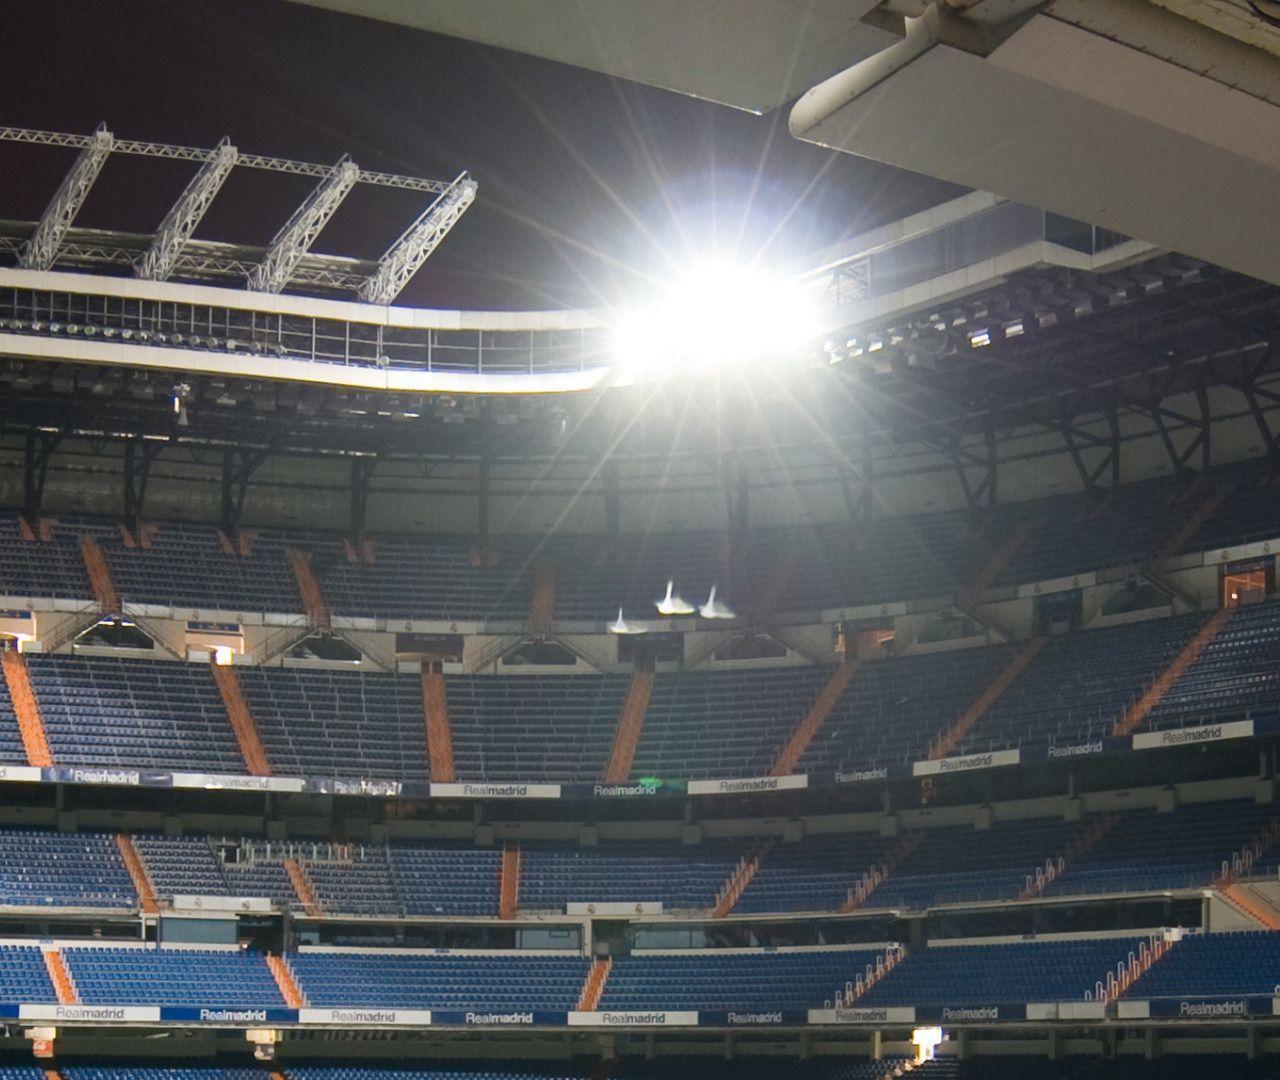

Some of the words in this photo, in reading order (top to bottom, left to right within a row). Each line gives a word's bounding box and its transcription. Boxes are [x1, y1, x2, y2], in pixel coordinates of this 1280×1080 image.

[1163, 727, 1222, 744] Realmadrid
[1049, 741, 1103, 757] Realmadrid
[464, 785, 527, 797] Realmadrid
[720, 779, 778, 791] Realmadrid
[56, 1007, 124, 1019] Realmadrid
[200, 1009, 267, 1022] Realmadrid
[332, 1011, 396, 1023] Realmadrid
[466, 1012, 533, 1025] Realmadrid
[603, 1012, 666, 1024] Realmadrid
[728, 1011, 782, 1024] Realmadrid
